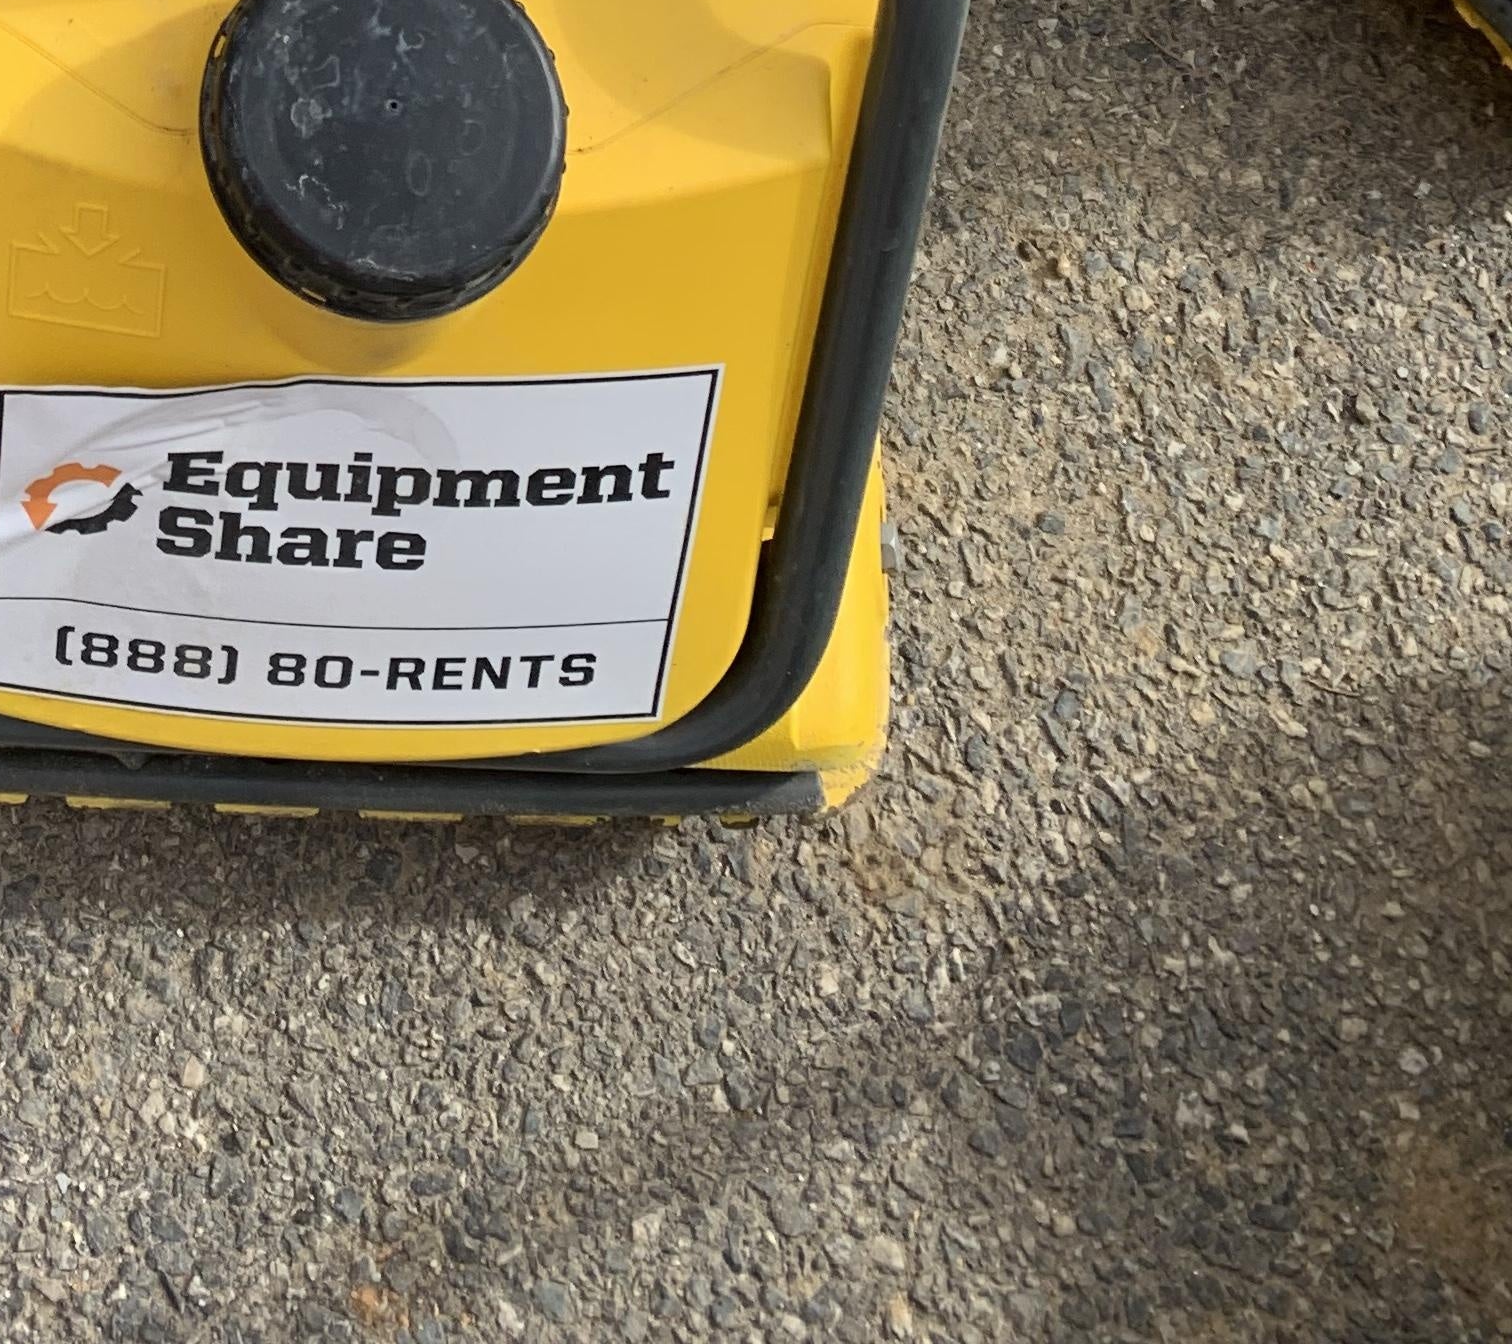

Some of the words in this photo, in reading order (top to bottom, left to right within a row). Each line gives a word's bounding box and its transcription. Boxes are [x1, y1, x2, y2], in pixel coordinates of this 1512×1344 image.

[162, 450, 676, 516] Equipment
[155, 505, 427, 572] Share
[54, 625, 239, 685] (888)
[266, 652, 598, 691] 80-RENTS
